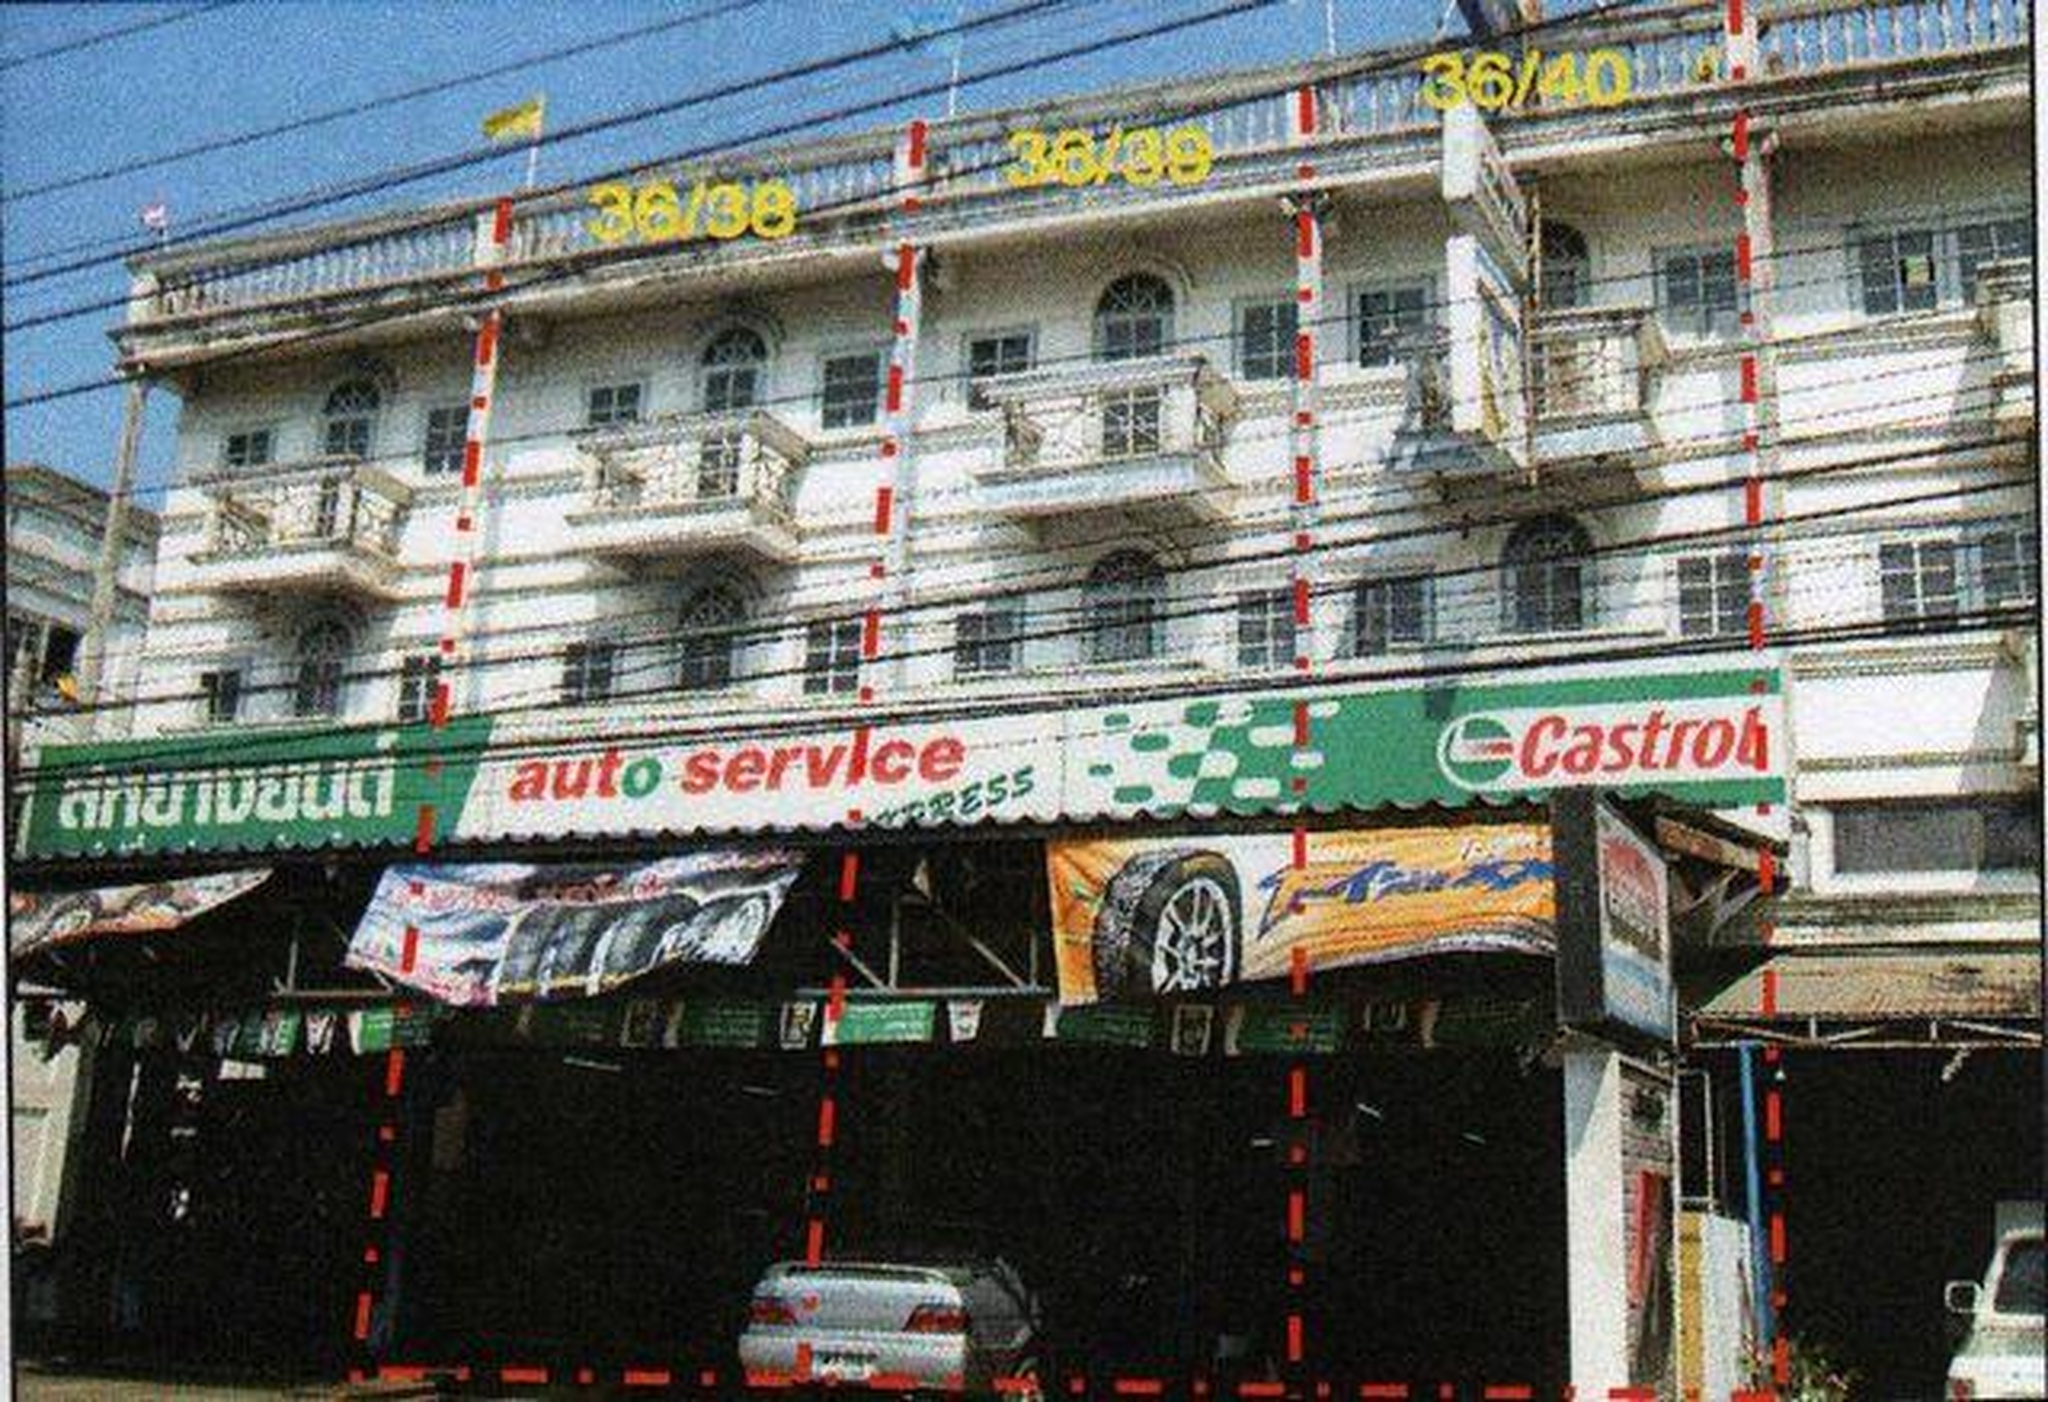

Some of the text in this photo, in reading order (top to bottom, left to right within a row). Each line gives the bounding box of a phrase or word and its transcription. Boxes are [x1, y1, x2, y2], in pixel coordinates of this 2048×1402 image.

[509, 731, 966, 801] auto service
[1519, 706, 1766, 778] Castrol
